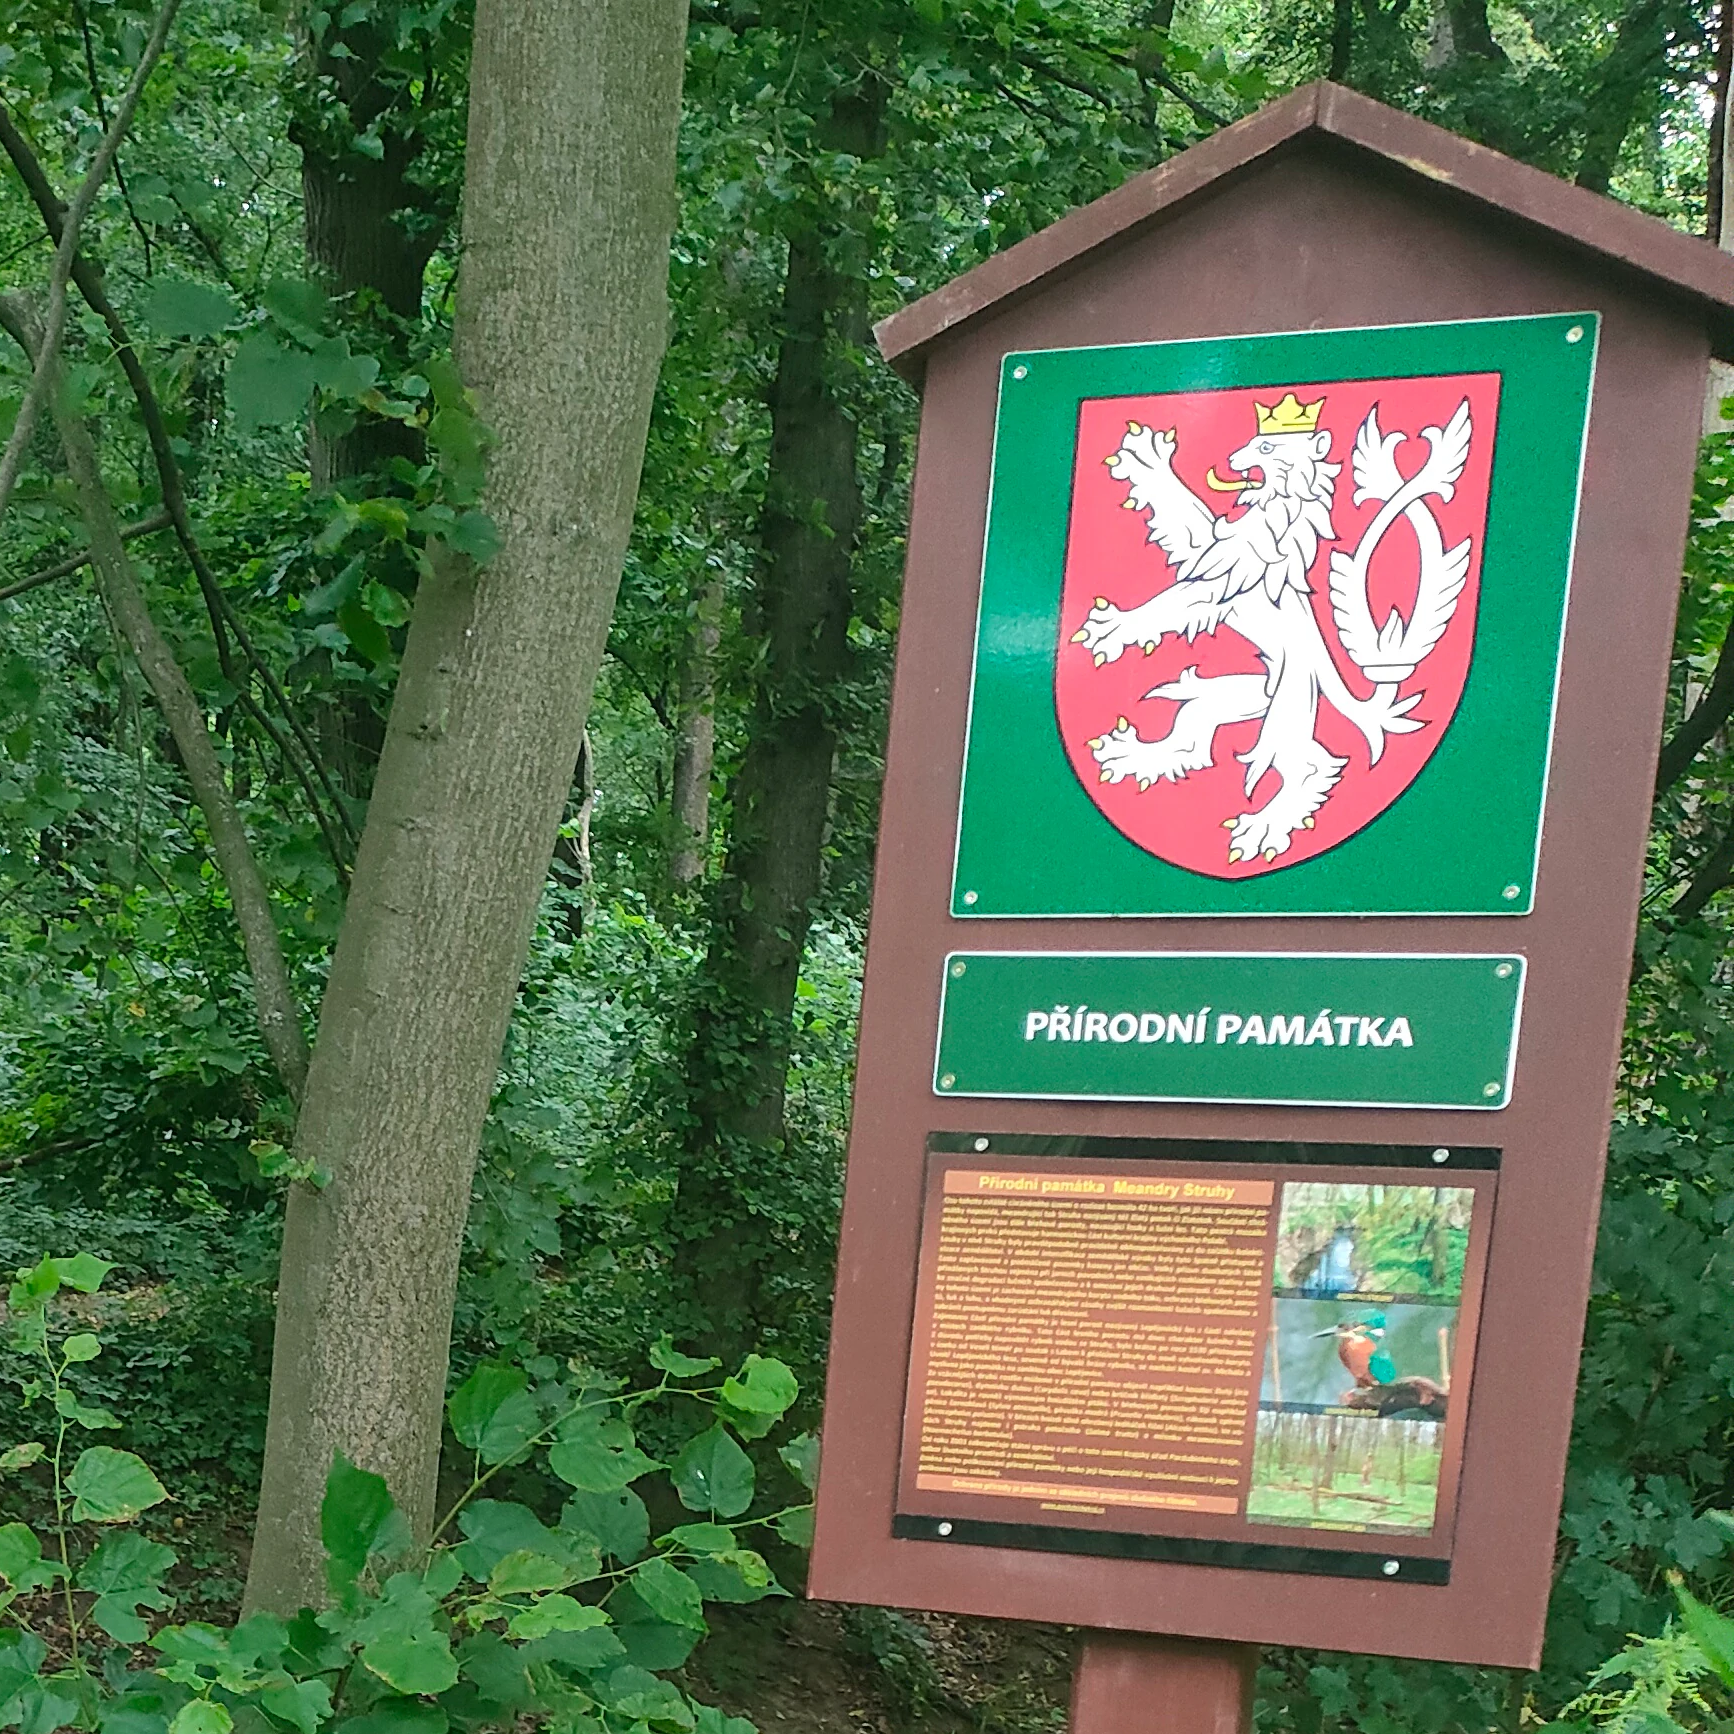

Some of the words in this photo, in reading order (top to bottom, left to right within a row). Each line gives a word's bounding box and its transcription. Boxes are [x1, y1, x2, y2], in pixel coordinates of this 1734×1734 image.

[1025, 1006, 1212, 1044] PŘÍRODNÍ
[1216, 1008, 1414, 1047] PAMÁTKA
[1042, 1179, 1105, 1194] památka
[1113, 1180, 1180, 1199] Meandry
[1183, 1182, 1235, 1201] Struhy
